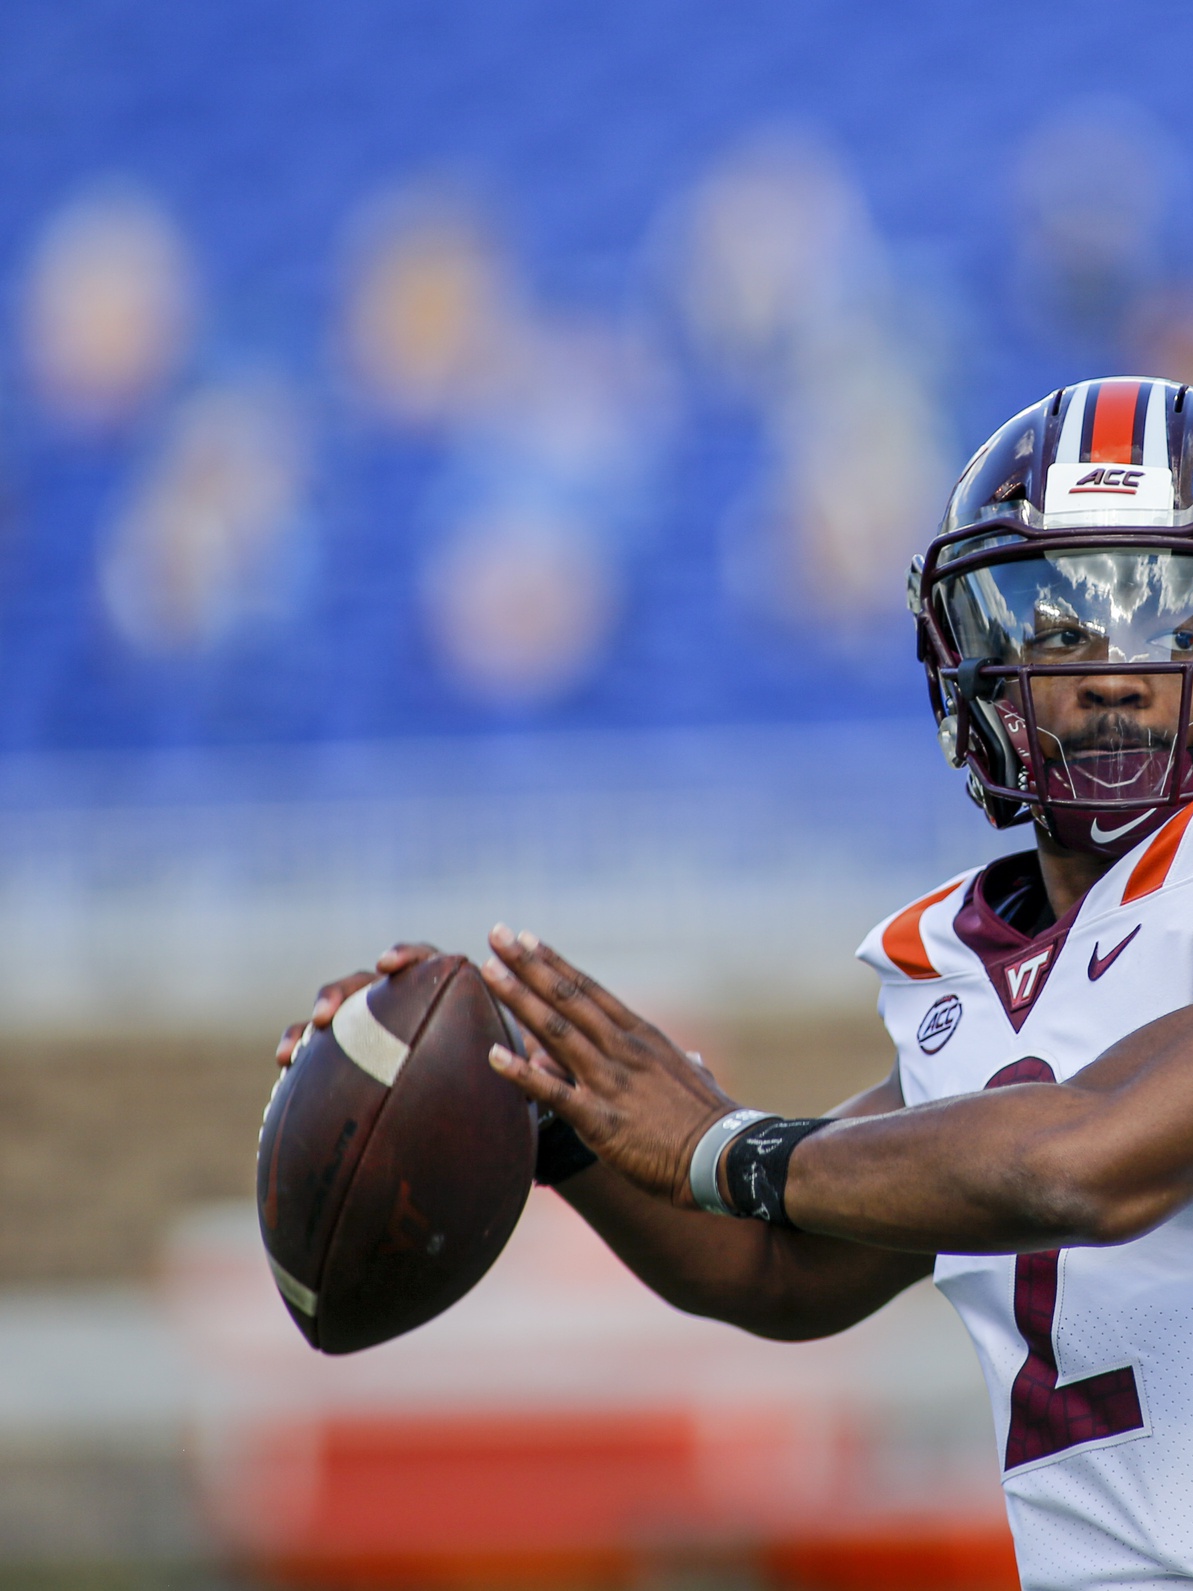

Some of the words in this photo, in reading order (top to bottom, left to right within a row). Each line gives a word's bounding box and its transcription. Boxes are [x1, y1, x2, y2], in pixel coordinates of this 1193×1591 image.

[1076, 468, 1146, 488] ACC
[1005, 946, 1053, 1006] VT
[923, 1003, 958, 1036] ACC
